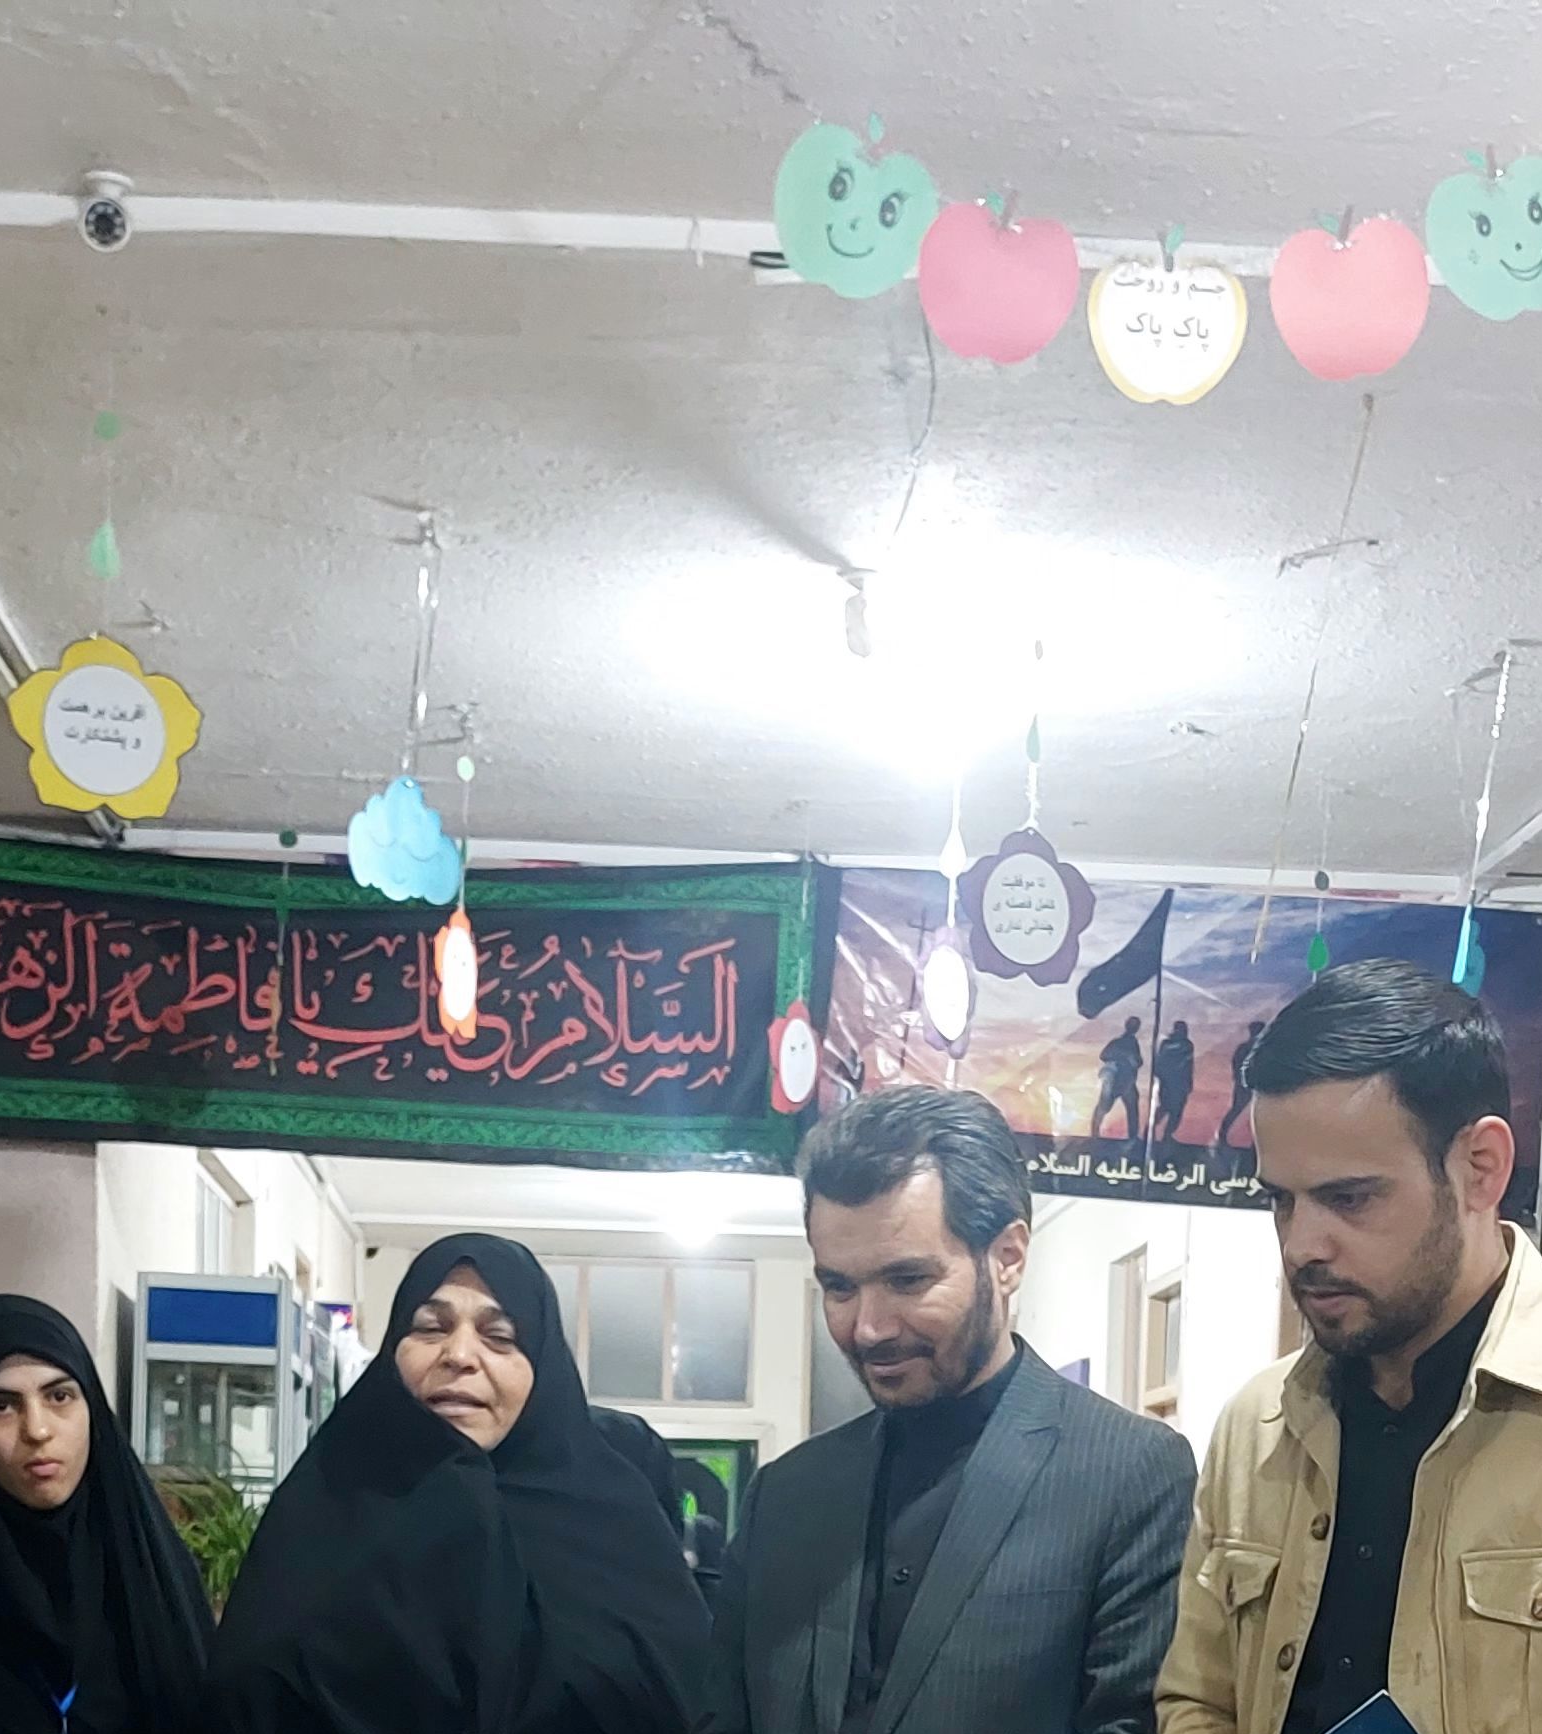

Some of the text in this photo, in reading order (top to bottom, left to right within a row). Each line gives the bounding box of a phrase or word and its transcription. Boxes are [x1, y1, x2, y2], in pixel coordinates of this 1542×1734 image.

[1171, 280, 1180, 295] و
[1125, 312, 1162, 348] پاک
[132, 737, 141, 749] و
